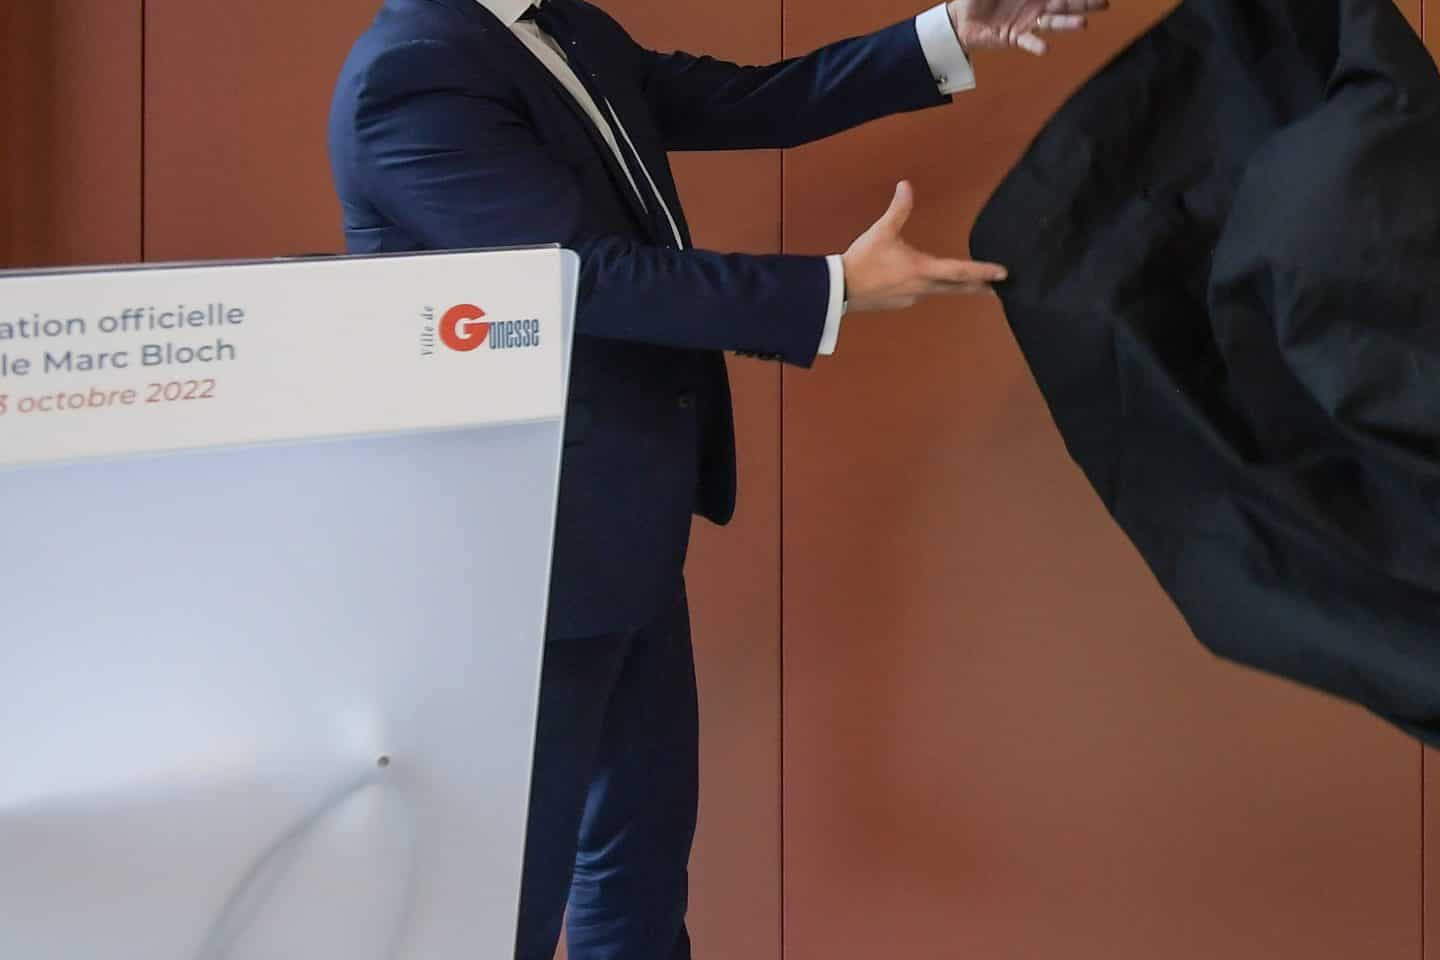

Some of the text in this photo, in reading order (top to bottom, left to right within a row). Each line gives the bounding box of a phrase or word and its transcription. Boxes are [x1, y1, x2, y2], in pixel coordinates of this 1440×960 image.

[98, 303, 245, 334] officielle
[438, 303, 540, 352] Gonesse
[43, 349, 129, 375] Marc
[141, 339, 236, 367] Bloch
[17, 387, 137, 414] octobre
[145, 378, 216, 403] 2022
